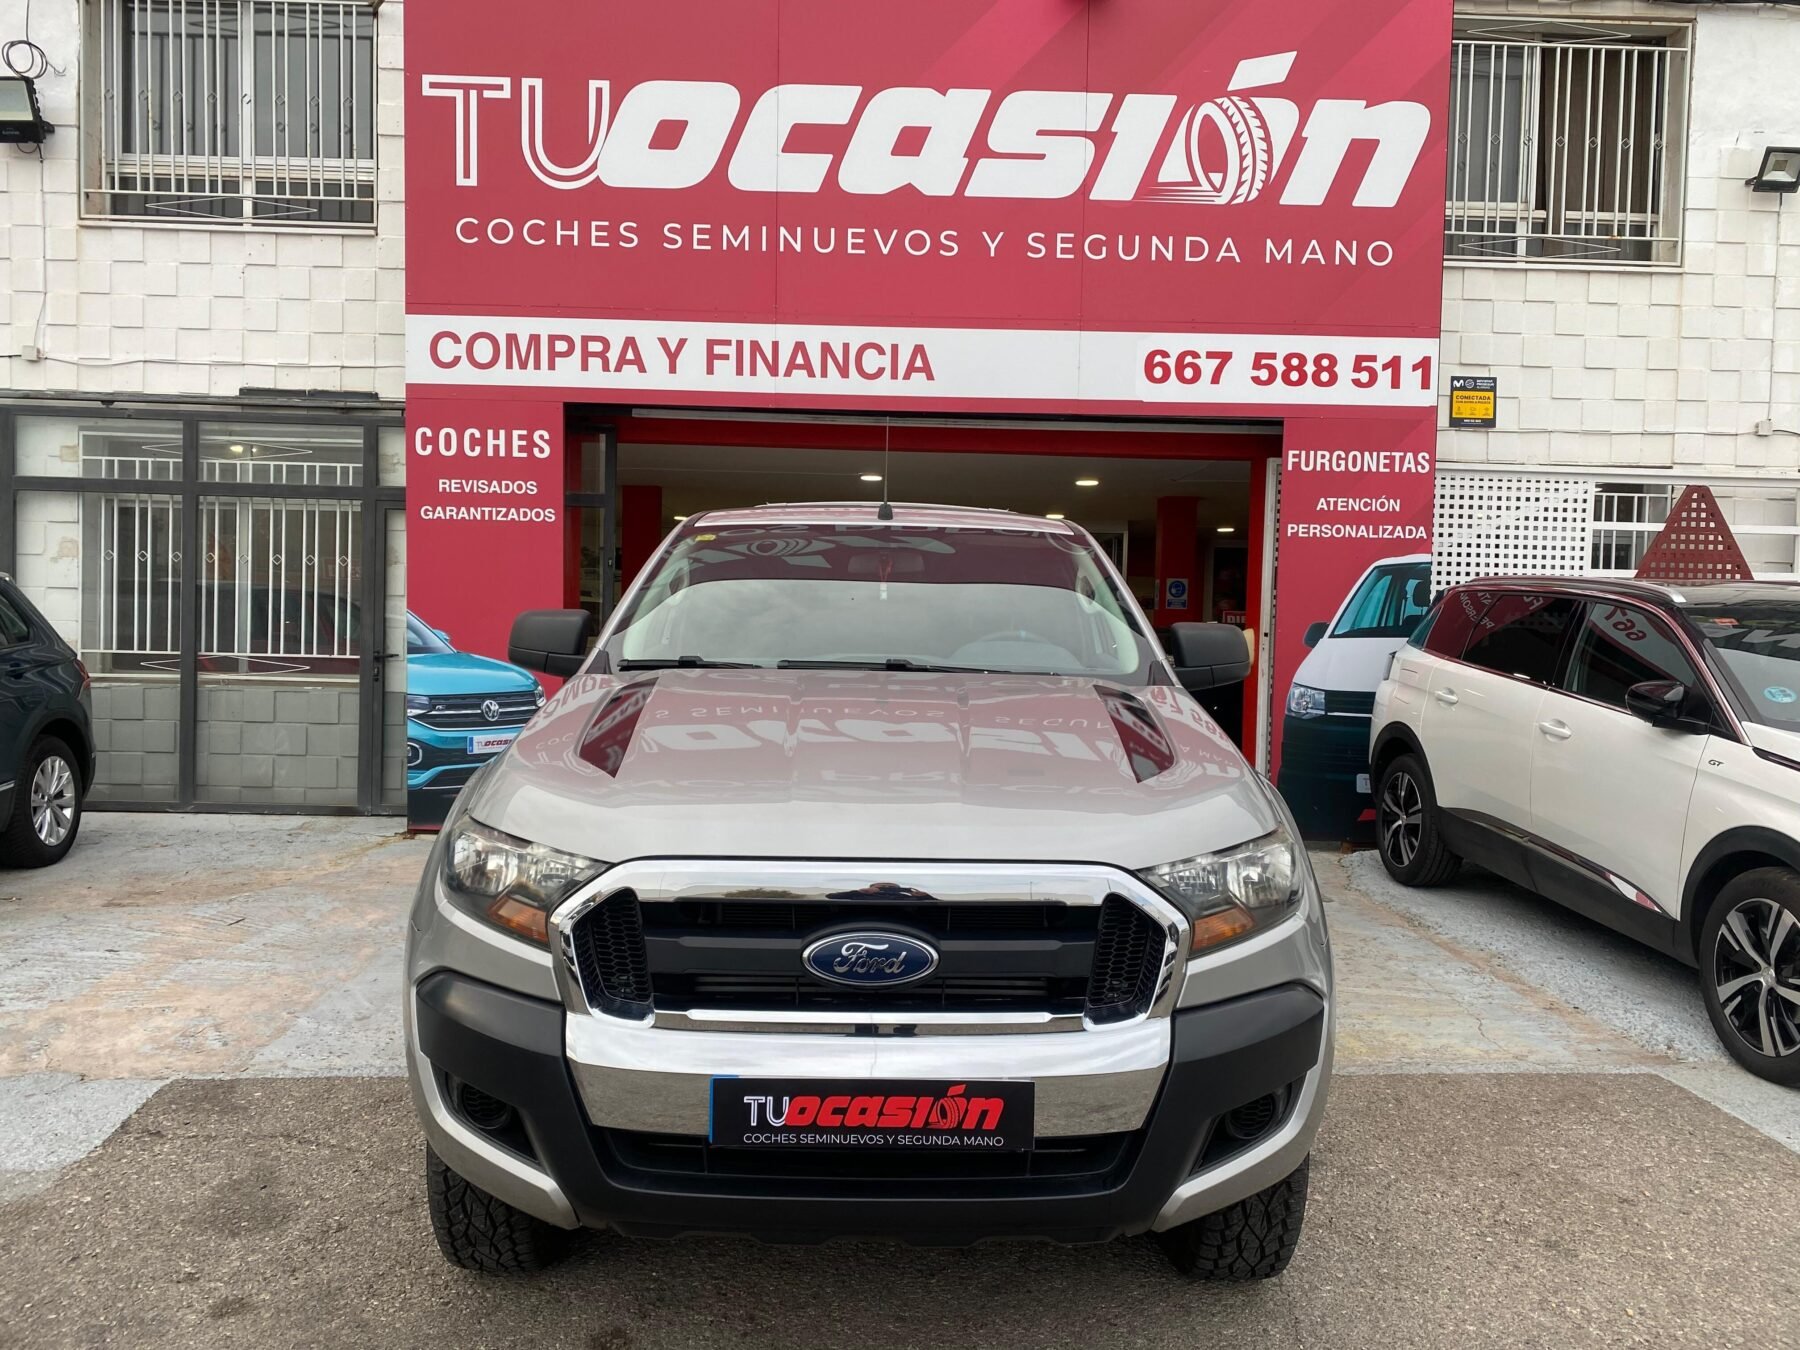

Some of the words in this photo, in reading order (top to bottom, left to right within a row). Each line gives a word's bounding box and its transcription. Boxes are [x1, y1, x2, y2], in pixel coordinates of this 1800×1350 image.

[455, 217, 639, 248] COCHES
[663, 222, 959, 257] SEMINUEVOS
[981, 231, 1004, 257] Y
[1026, 232, 1241, 263] SEGUNDA
[1264, 238, 1395, 267] MANO
[429, 330, 648, 374] COMPRA
[656, 337, 688, 375] Y
[706, 338, 935, 381] FINANCIA
[1144, 349, 1233, 385] 667
[1250, 351, 1339, 388] 588
[1351, 354, 1432, 390] 511
[415, 426, 551, 459] COCHES
[1287, 450, 1430, 474] FURGONETAS
[438, 478, 538, 495] REVISADOS
[420, 505, 556, 522] GARANTIZADOS
[1316, 494, 1401, 512] ATENCIÓN
[1287, 523, 1427, 539] PERSONALIZADA
[1708, 759, 1724, 767] GT
[833, 941, 907, 975] Ford
[743, 1133, 797, 1144] COCHES
[799, 1134, 885, 1145] SEMINUEVOS
[886, 1135, 895, 1145] Y
[897, 1134, 961, 1146] SEGUNDA
[964, 1136, 1004, 1147] MANO
